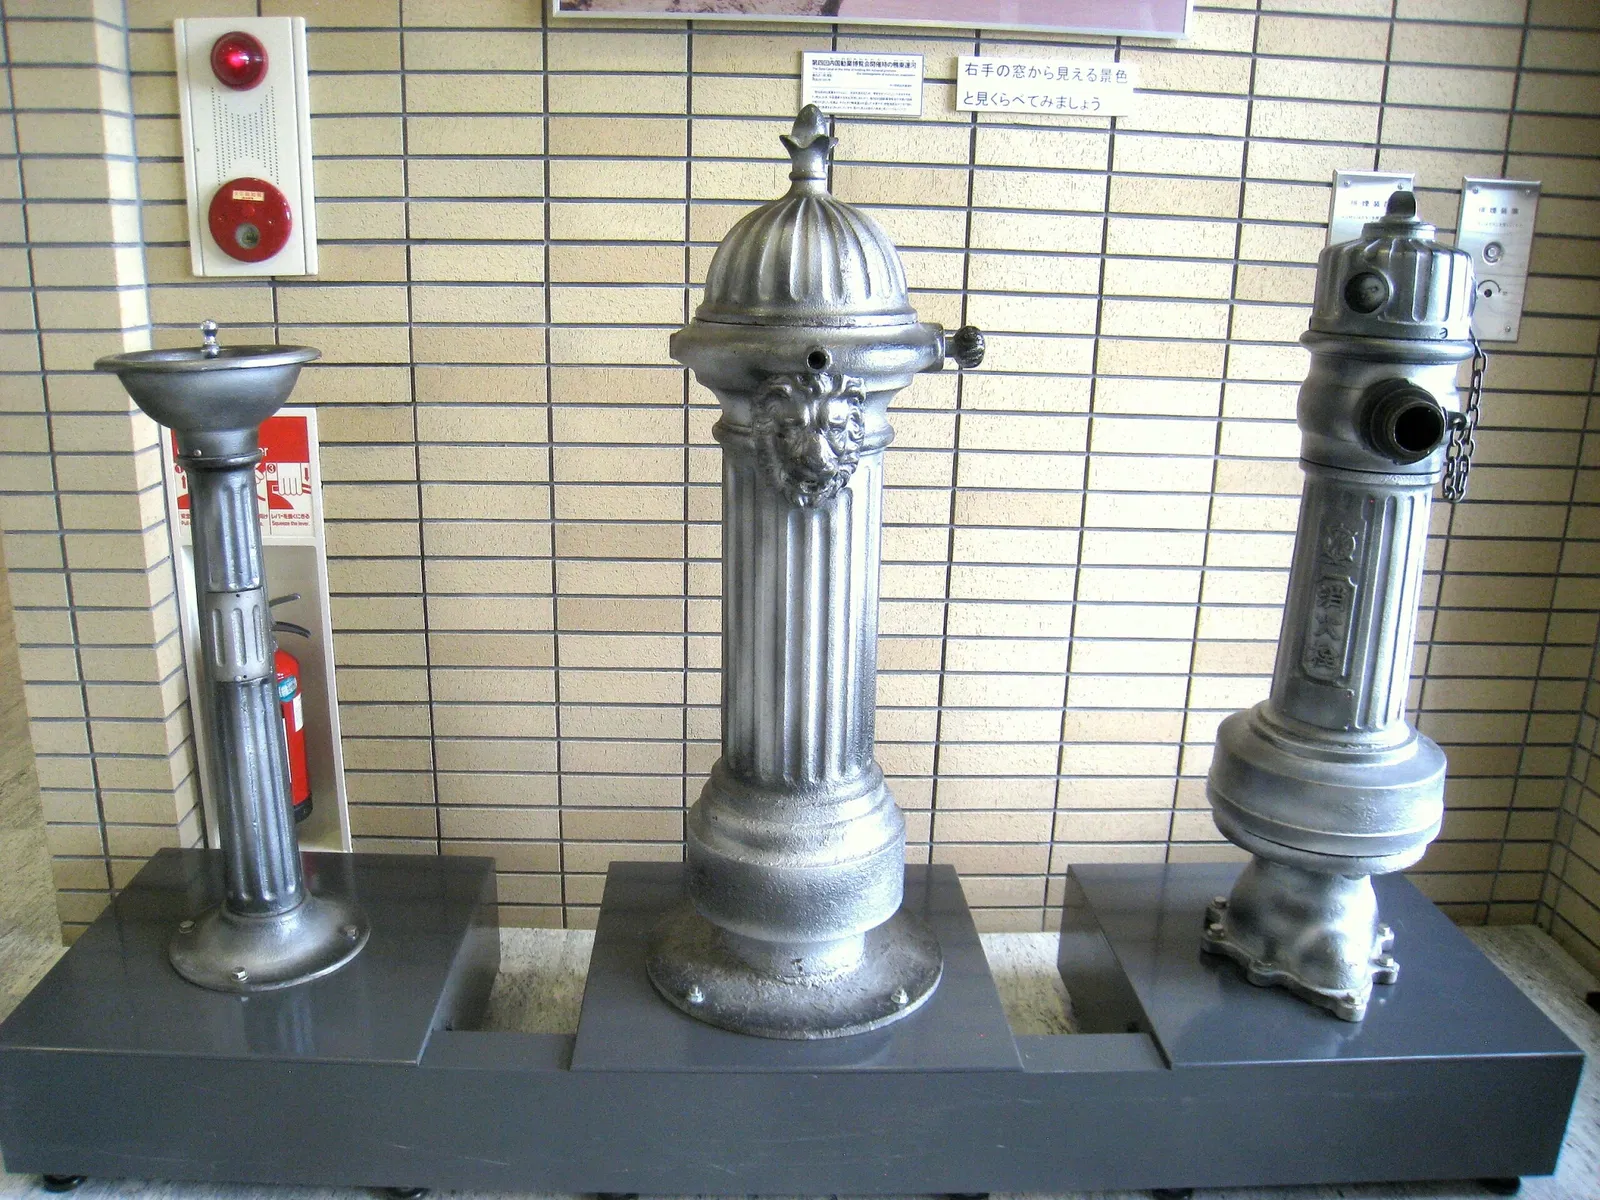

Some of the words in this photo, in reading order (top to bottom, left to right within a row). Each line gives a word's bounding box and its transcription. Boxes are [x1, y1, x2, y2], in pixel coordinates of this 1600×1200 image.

[964, 62, 1128, 84] 右手の窓から見える景色
[963, 90, 1101, 111] と見くらべてみましょう
